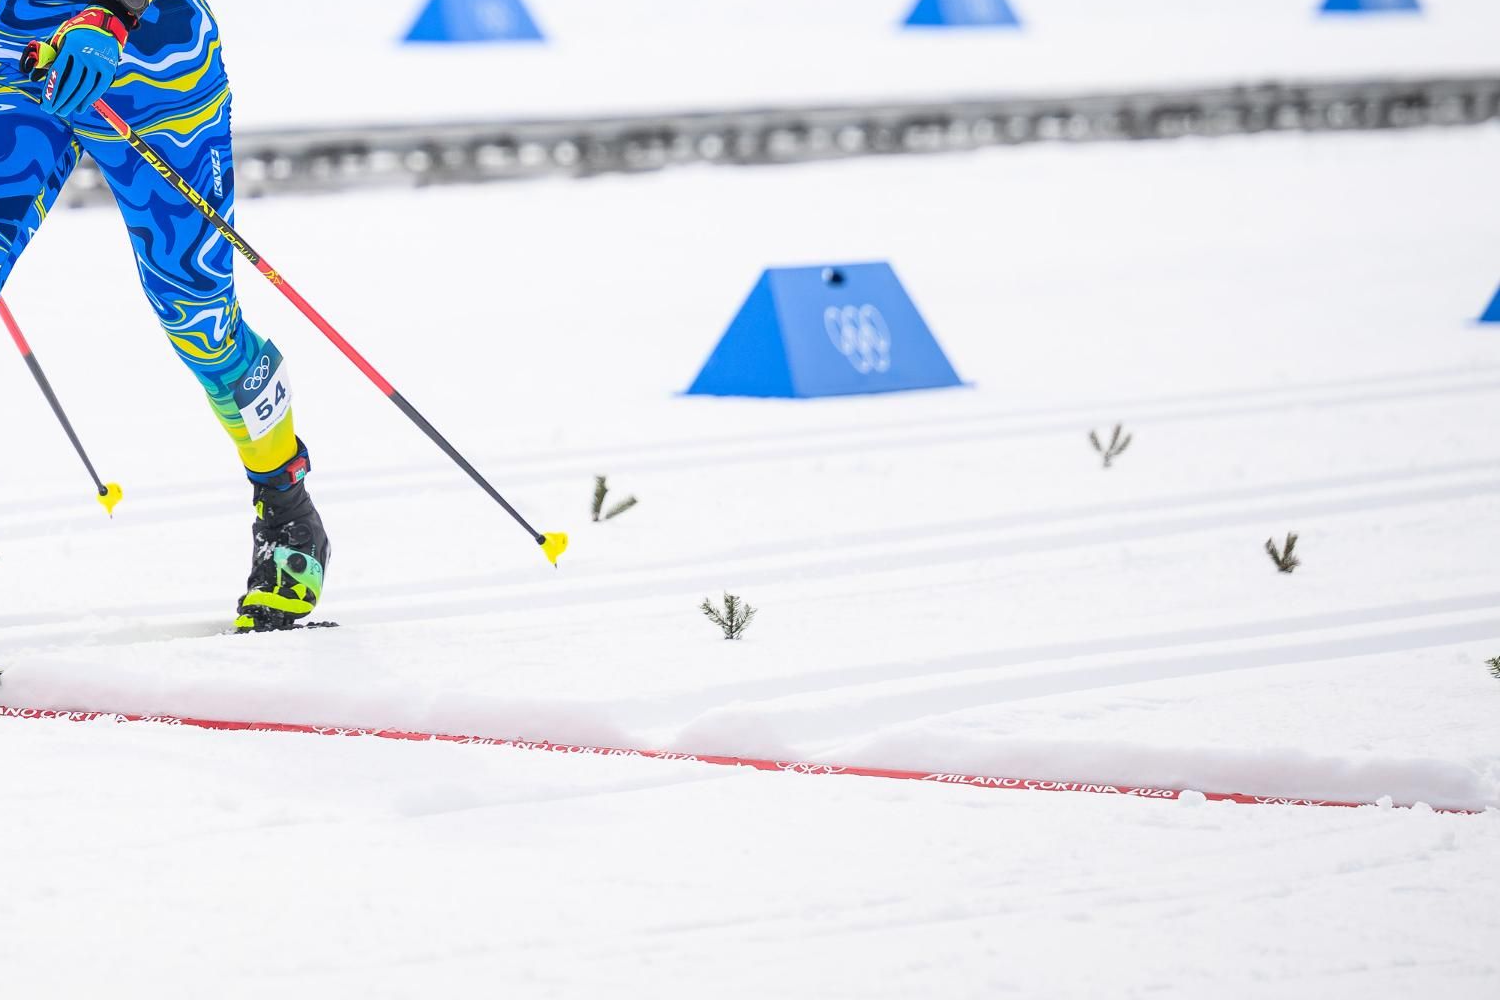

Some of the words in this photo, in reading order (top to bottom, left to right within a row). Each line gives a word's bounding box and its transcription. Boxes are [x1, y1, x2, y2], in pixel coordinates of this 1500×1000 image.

[44, 69, 58, 101] KV+
[210, 146, 224, 200] KV+
[177, 177, 215, 218] LEKI
[255, 380, 286, 421] 54
[921, 773, 1021, 787] MILANO
[1024, 779, 1122, 795] CORTINA
